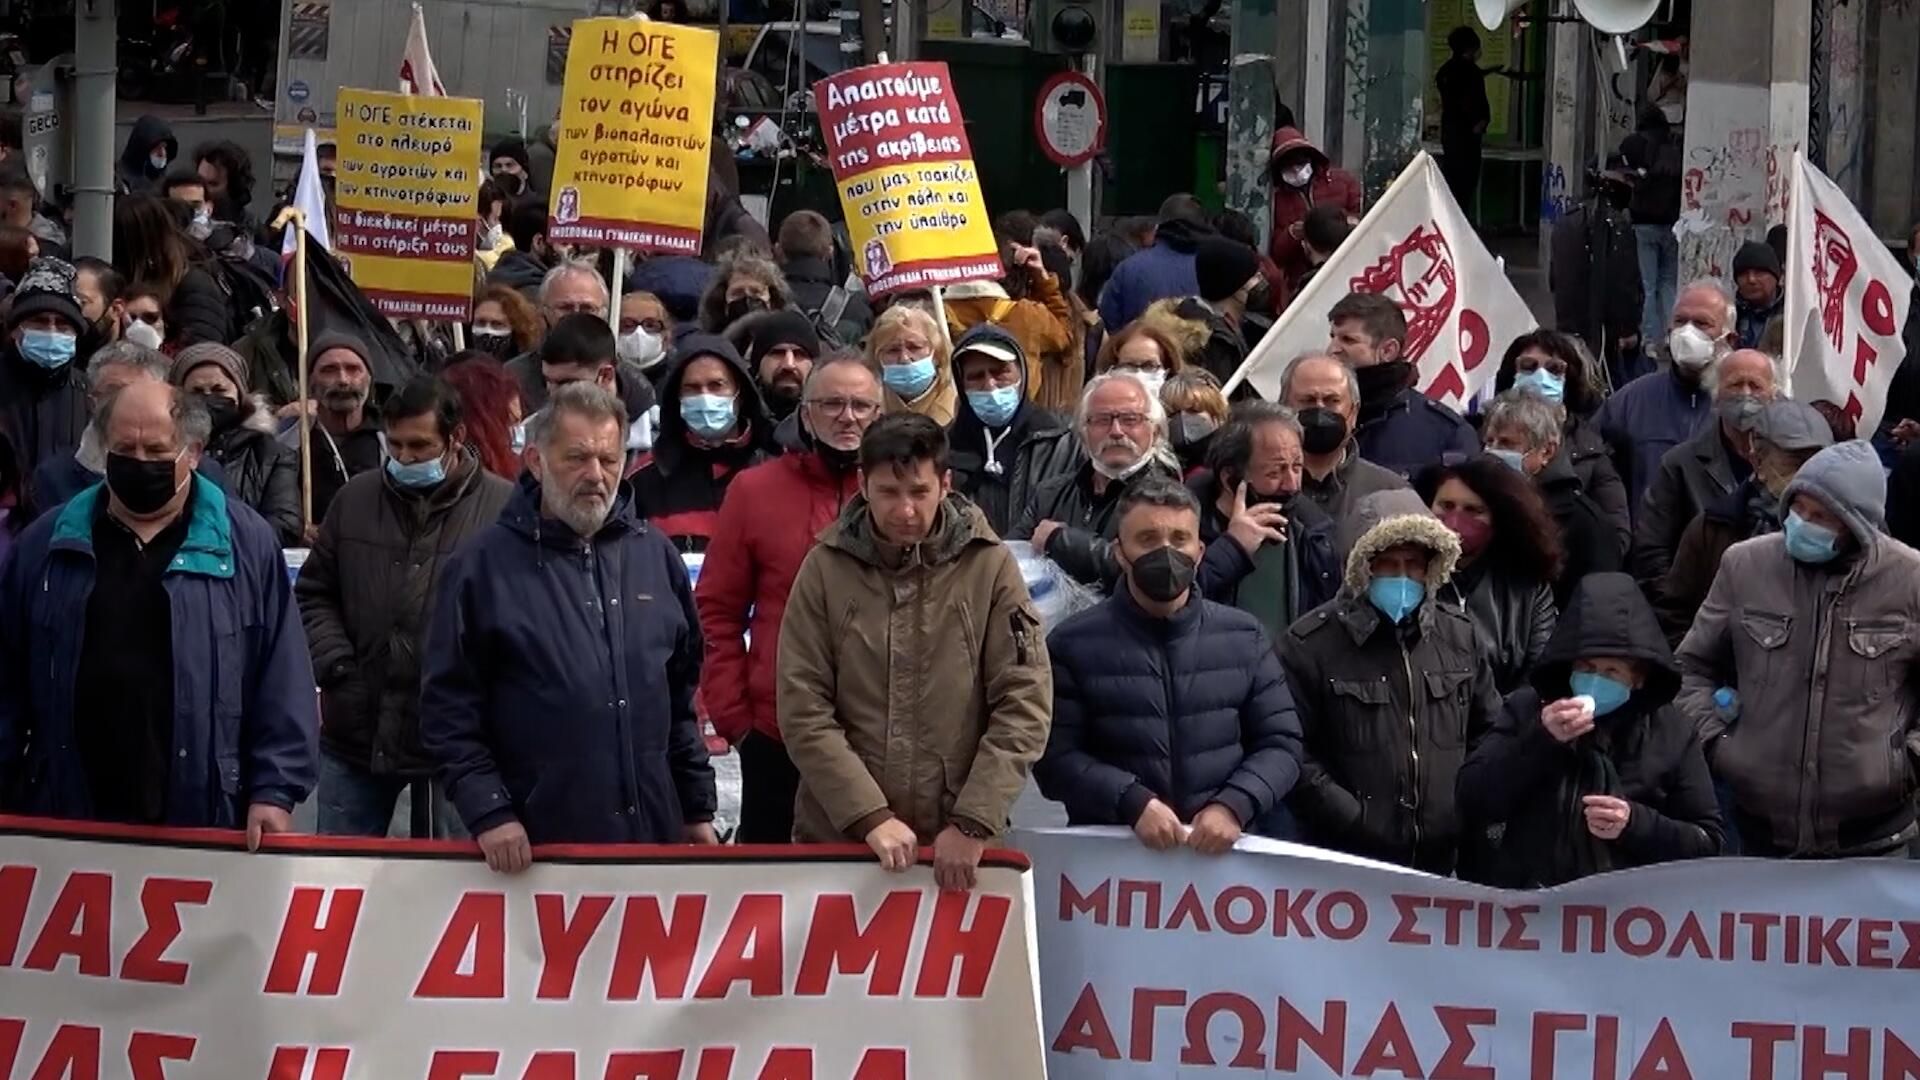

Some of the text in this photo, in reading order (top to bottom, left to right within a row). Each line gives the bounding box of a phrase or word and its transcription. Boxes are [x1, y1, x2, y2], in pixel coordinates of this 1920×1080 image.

[602, 30, 675, 60] Η ΟΓΕ
[590, 62, 683, 91] στηρίζει
[828, 70, 942, 110] Απαιτούμε
[344, 102, 472, 131] Η ΟΓΕ στέκεται
[580, 97, 689, 122] τον αγώνα
[834, 100, 951, 146] μέτρα κατά
[357, 132, 452, 156] στο πλευρό
[565, 123, 705, 150] των βιοπαλαιστών
[837, 131, 961, 168] της ακρίβειας
[370, 163, 437, 179] αγροτών
[445, 169, 467, 181] και
[580, 149, 680, 170] αγροτών και
[574, 170, 683, 192] κτηνοτρόφων
[846, 163, 974, 198] που μας τσακίζει
[365, 185, 471, 206] κτηνοτρόφων
[862, 187, 969, 216] στην πόλη και
[355, 211, 417, 231] διεκδικεί
[422, 219, 468, 237] μέτρα
[875, 208, 967, 235] την ύπαιθρο
[353, 235, 367, 246] τη
[372, 236, 429, 254] στήριξη
[434, 242, 468, 256] τους
[655, 235, 696, 250] ΕΛΛΑΔΑΣ
[0, 864, 1011, 999] ΑΣ Η ΔΥΝΑΜΗ
[1059, 873, 1920, 969] ΜΠΛΟΚΟ ΣΤΙΣ ΠΟΛΙΤΙΚΕΣ
[1052, 982, 1497, 1080] ΑΓΩΝΑΣ
[1530, 1011, 1694, 1080] ΓΙΑ
